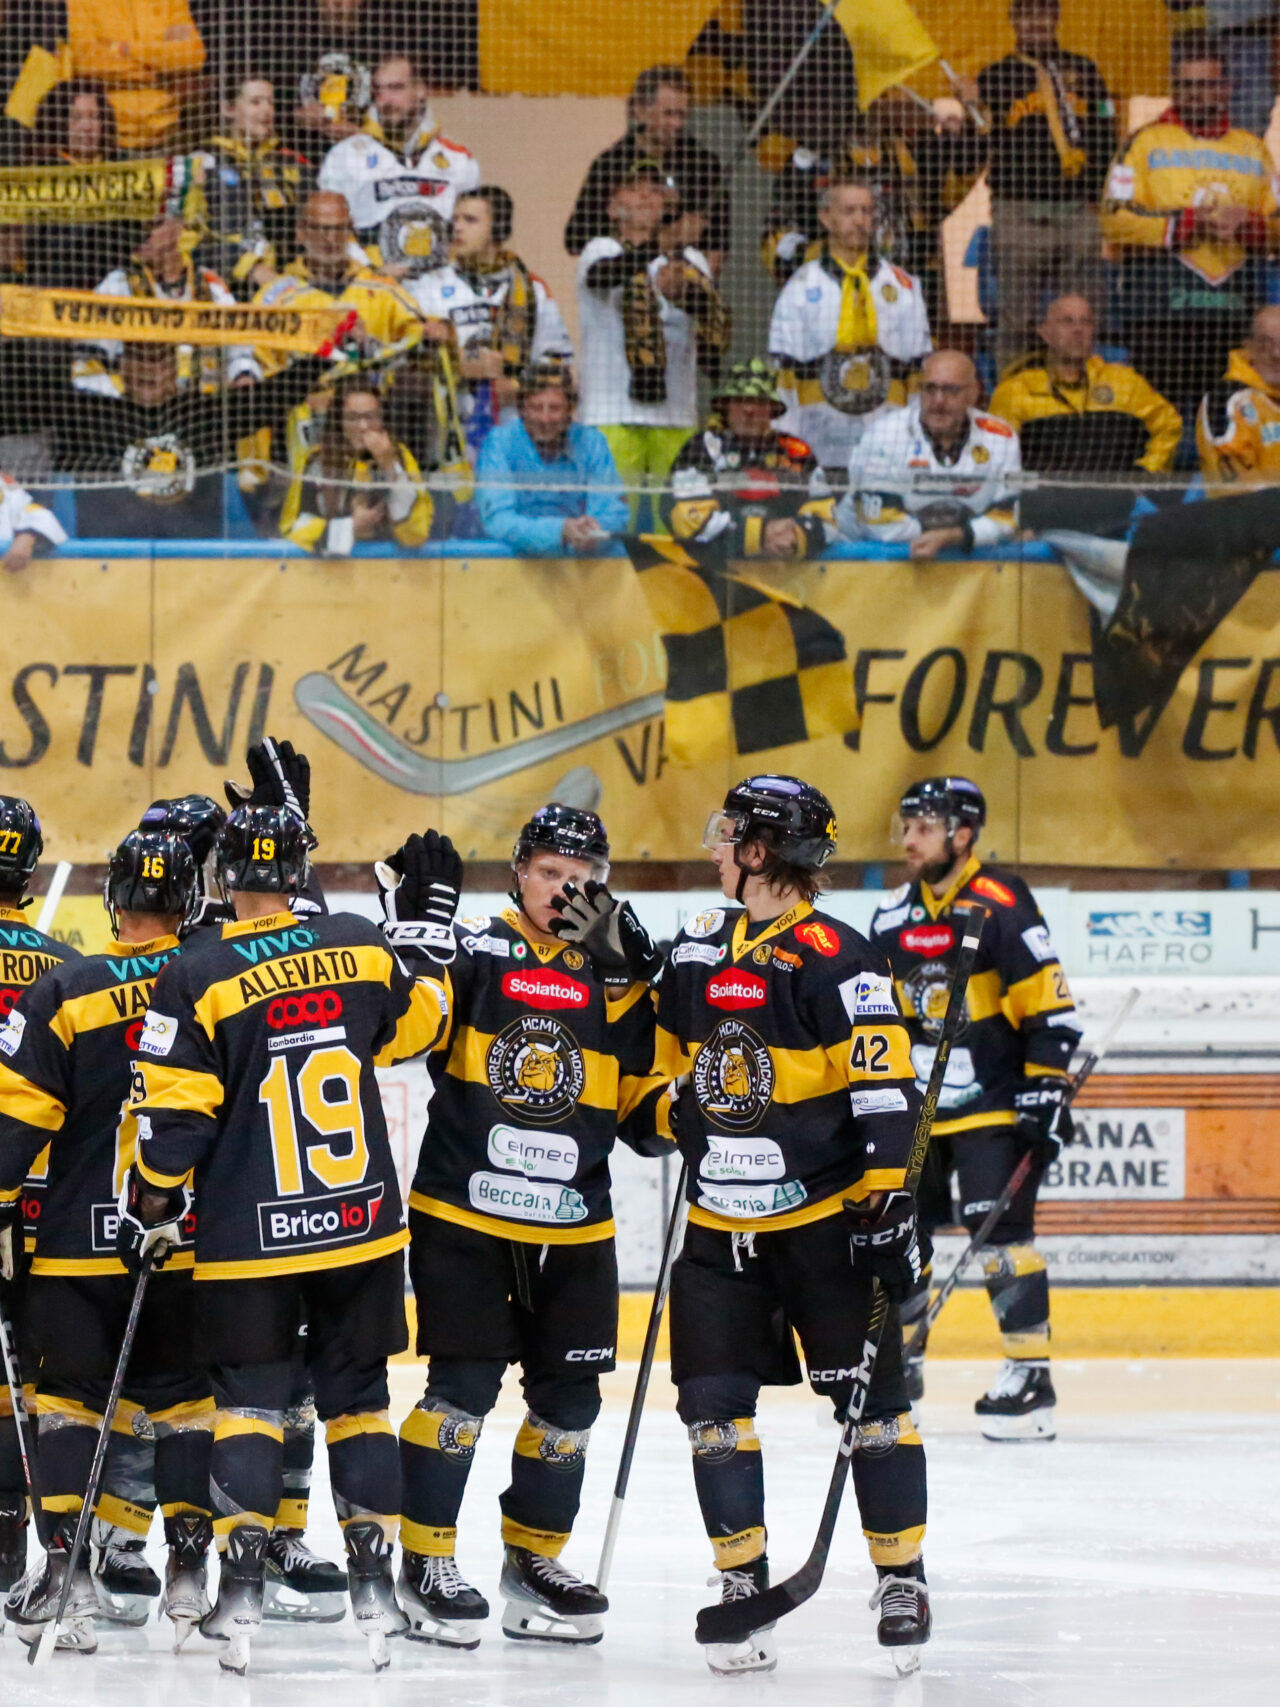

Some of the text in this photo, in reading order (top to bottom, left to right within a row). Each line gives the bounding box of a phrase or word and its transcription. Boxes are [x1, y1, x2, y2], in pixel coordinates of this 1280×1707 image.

[52, 299, 185, 330] GIALLONERA
[325, 642, 566, 752] MASTINI
[752, 807, 780, 819] CCM
[556, 827, 587, 840] CCM
[252, 837, 276, 861] 19
[141, 855, 165, 879] 16
[252, 916, 277, 931] yop!
[773, 908, 798, 932] yop!
[232, 929, 315, 964] VIVO
[537, 945, 552, 957] 87
[1088, 942, 1213, 964] HAFRO
[238, 950, 358, 1005] ALLEVATO
[509, 978, 583, 1002] Scoiattolo
[709, 982, 764, 1000] Soiattolo
[266, 989, 343, 1029] coop
[521, 1017, 561, 1035] HCMV
[269, 1033, 315, 1048] Lombardia
[849, 1034, 890, 1073] 42
[488, 1037, 510, 1095] VARESE
[694, 1046, 716, 1105] VARESE
[752, 1047, 773, 1106] HOCKEY
[258, 1045, 370, 1197] 19
[906, 1092, 939, 1177] TACKS
[507, 1139, 577, 1165] elmec
[708, 1150, 780, 1167] elmec
[1041, 1159, 1170, 1187] BRANE
[964, 1200, 1010, 1216] CC
[852, 1213, 917, 1247] CCM
[1067, 1250, 1176, 1264] CORPORATION
[565, 1346, 615, 1362] CCM
[809, 1366, 858, 1382] CCM
[839, 1339, 878, 1458] CCM
